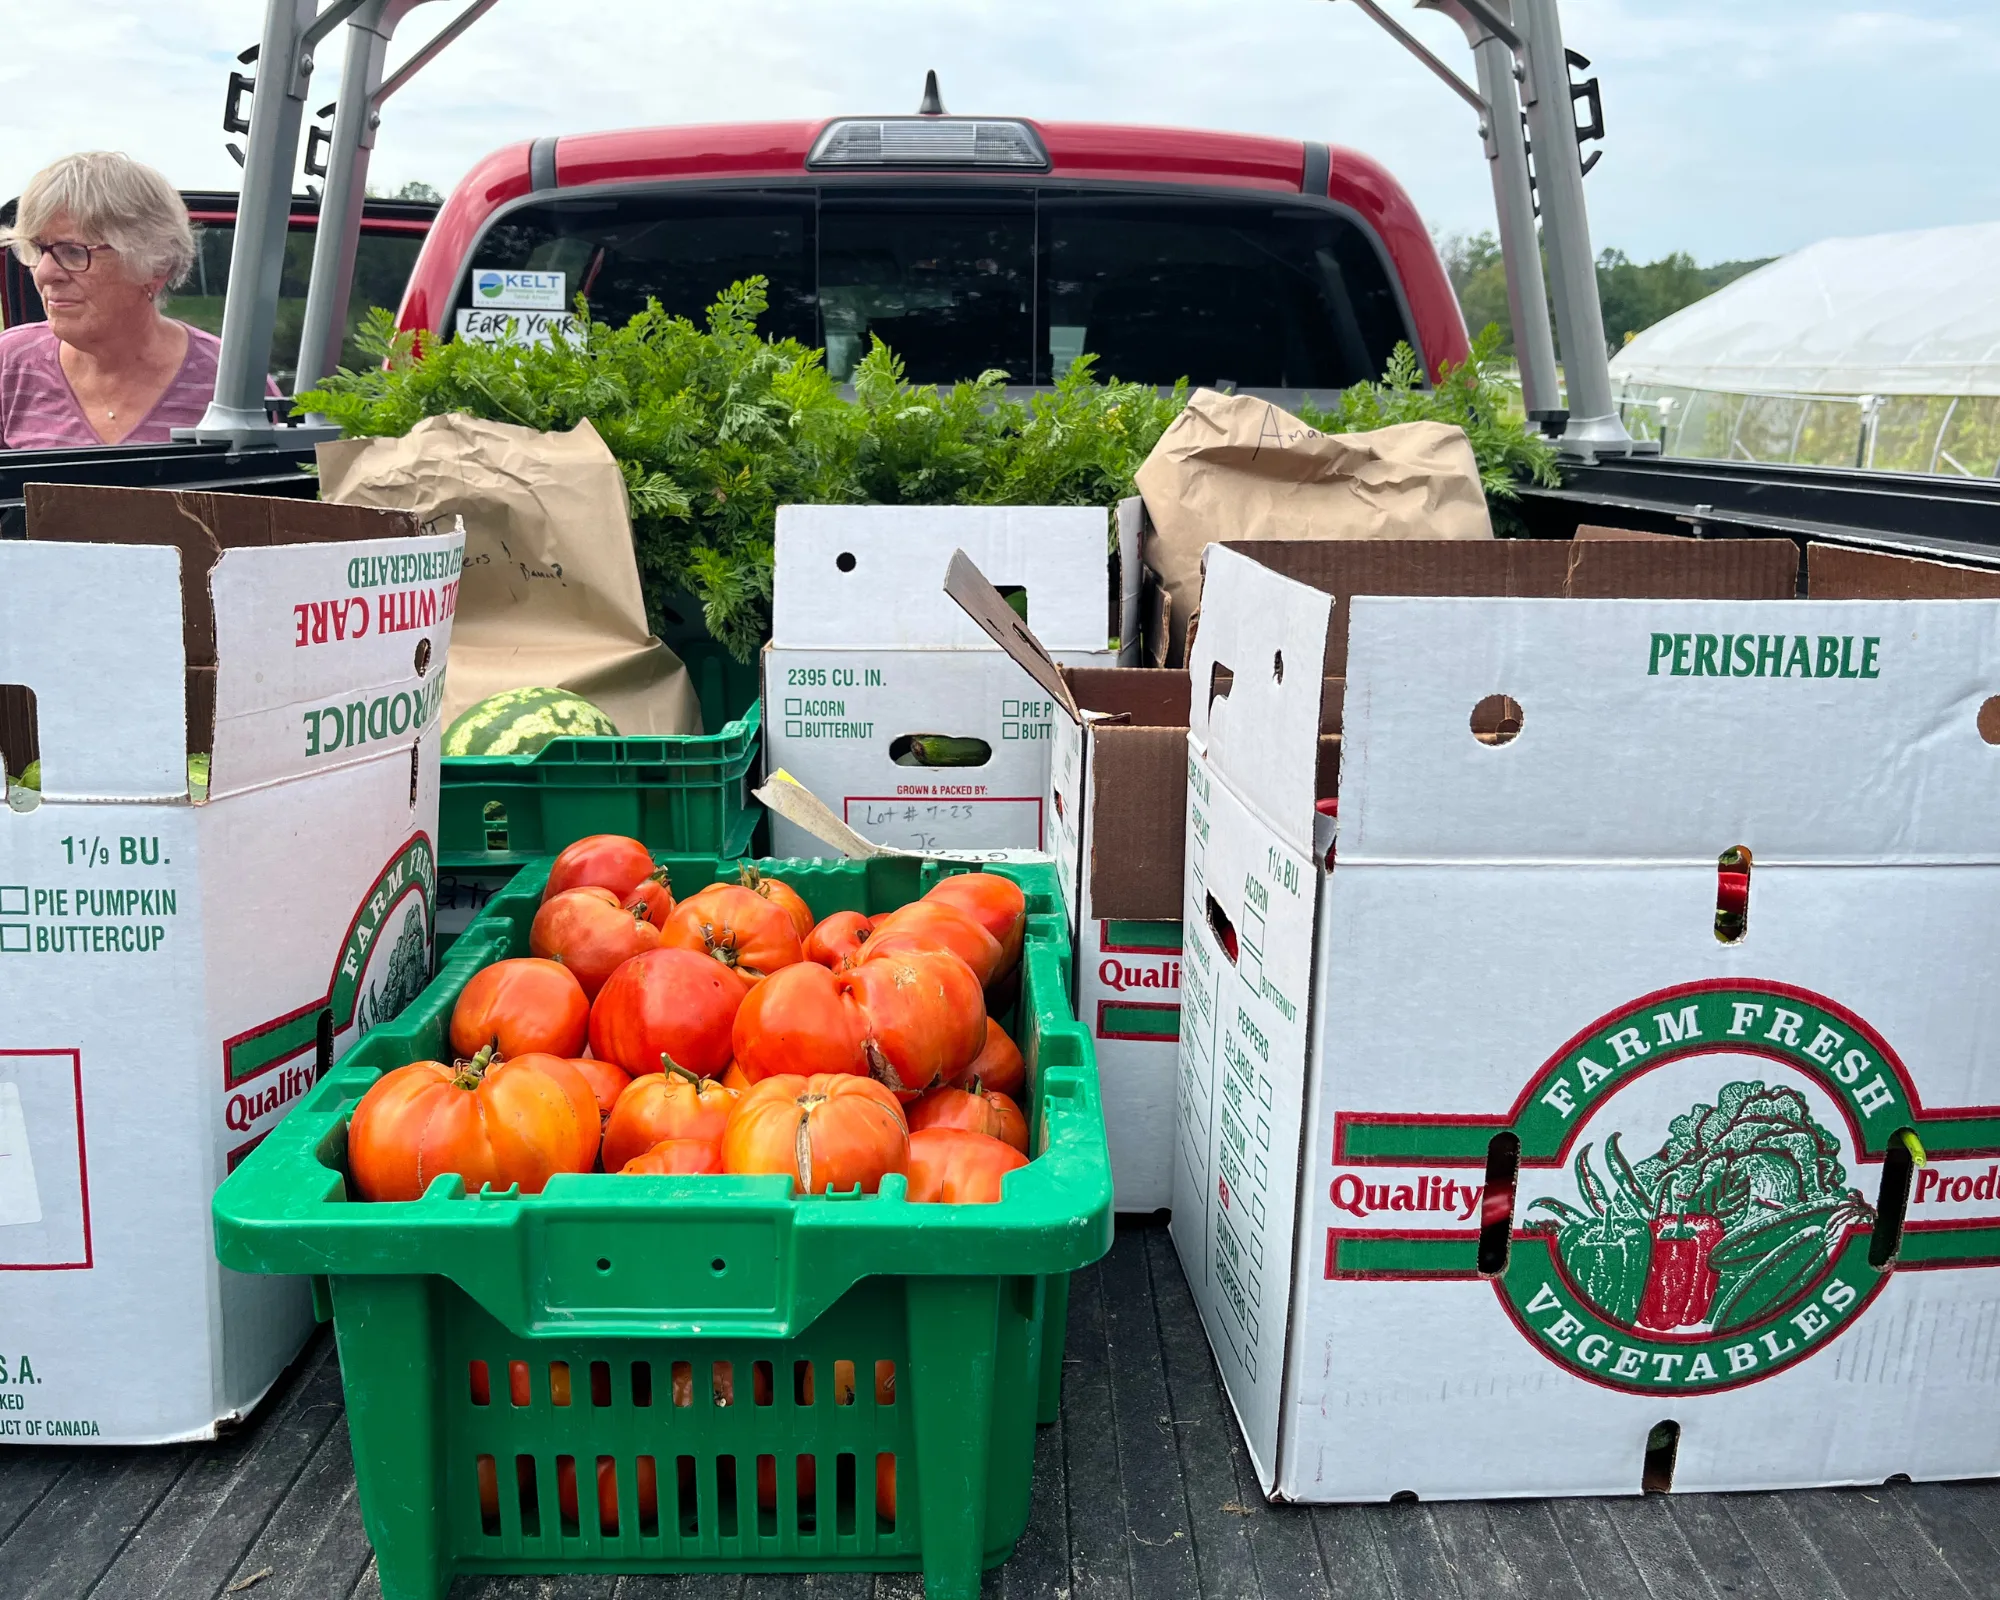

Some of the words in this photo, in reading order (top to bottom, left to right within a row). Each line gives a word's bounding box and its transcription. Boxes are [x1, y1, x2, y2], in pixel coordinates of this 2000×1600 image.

[505, 274, 561, 288] KELT
[348, 551, 450, 588] REFRIGERATED
[462, 553, 491, 568] ers
[293, 596, 370, 647] CARE
[378, 588, 437, 634] WITH
[1647, 632, 1881, 679] PERISHABLE
[788, 669, 826, 687] 2395
[832, 669, 860, 687] CU.
[864, 669, 887, 687] IN.
[303, 686, 431, 757] PRODUCE
[804, 700, 845, 717] ACORN
[1022, 701, 1041, 718] PIE
[1044, 701, 1053, 718] P
[804, 720, 874, 739] BUTTERNUT
[1022, 722, 1052, 740] BUTT
[896, 785, 929, 795] GROWN
[931, 785, 938, 795] &
[940, 785, 973, 795] PACKED
[975, 785, 988, 795] BY:
[866, 805, 898, 825] Lot
[119, 836, 171, 866] BU.
[1244, 872, 1269, 914] ACORN
[1284, 858, 1301, 899] BU.
[34, 889, 68, 916] PIE
[75, 889, 177, 917] PUMPKIN
[342, 861, 405, 982] FARM
[408, 846, 434, 910] FRESH
[36, 925, 165, 953] BUTTERCUP
[1098, 959, 1182, 992] Quali
[1261, 976, 1297, 1024] BUTTERNUT
[1238, 1006, 1269, 1063] PEPPERS
[1225, 1029, 1255, 1090] EX-LARGE
[1540, 1004, 1704, 1120] FARM
[1726, 1001, 1895, 1120] FRESH
[226, 1062, 317, 1132] Quality
[1222, 1066, 1243, 1113] LARGE
[1221, 1103, 1246, 1160] MEDIUM
[1219, 1140, 1241, 1191] SELECT
[1913, 1164, 2000, 1204] Prod
[1218, 1175, 1230, 1210] RED
[1329, 1173, 1484, 1221] Quality
[1216, 1212, 1240, 1270] SUNTAN
[1216, 1247, 1246, 1321] CHOPPERS
[1525, 1276, 1859, 1383] VEGETABLES
[0, 1354, 42, 1385] S.A.
[0, 1393, 24, 1410] KED
[0, 1419, 21, 1436] UCT
[26, 1420, 42, 1436] OF
[46, 1420, 100, 1436] CANADA
